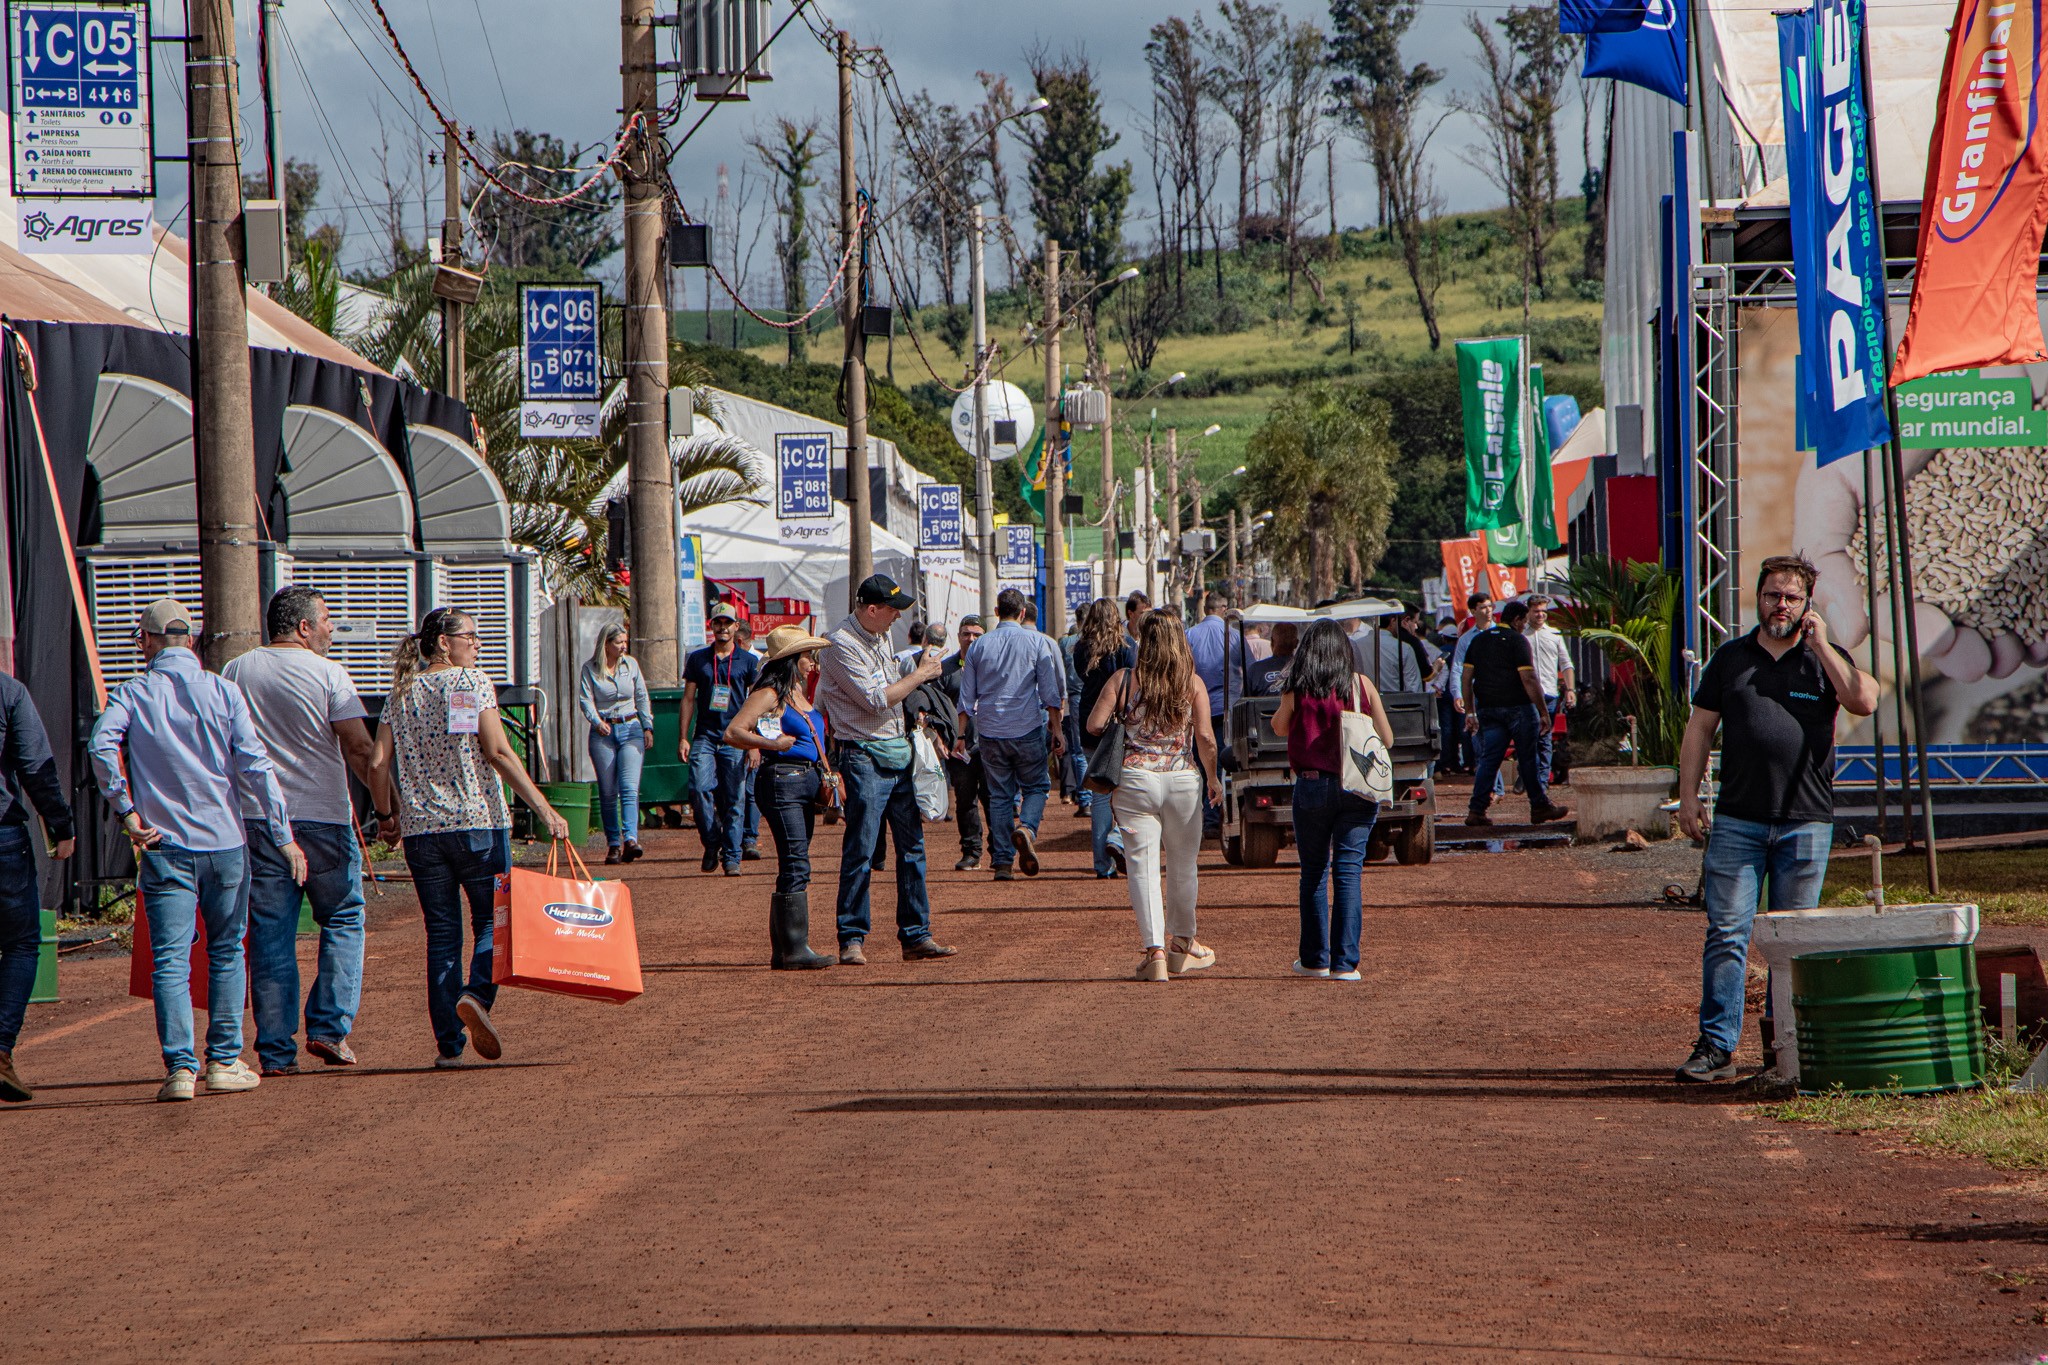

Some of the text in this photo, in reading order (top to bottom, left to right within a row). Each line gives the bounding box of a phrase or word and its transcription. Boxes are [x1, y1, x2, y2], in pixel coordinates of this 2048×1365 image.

[46, 20, 132, 66] C 05
[25, 87, 77, 101] D B
[88, 88, 131, 101] 4 6
[40, 109, 85, 118] SANITÁRIOS
[40, 129, 80, 137] IMPRENSA
[42, 148, 91, 158] SAÍDA NORTE
[42, 167, 65, 175] ARENA
[78, 168, 133, 176] CONHECIMENTO
[42, 177, 104, 186] Knowledge Arena
[1858, 190, 1871, 247] para
[53, 216, 143, 242] Agres
[541, 300, 593, 330] C 06
[563, 350, 583, 366] 07
[531, 363, 543, 380] D
[547, 358, 559, 375] B
[563, 371, 584, 387] 05
[1896, 390, 2015, 412] segurança
[541, 412, 596, 429] Agres
[1931, 416, 2031, 437] mundial.
[791, 445, 825, 467] C 07
[795, 487, 803, 499] B
[805, 480, 820, 492] 08
[784, 490, 792, 503] D
[806, 496, 820, 508] 06
[929, 491, 957, 510] C 08
[793, 526, 830, 539] Agres
[941, 532, 953, 543] 07
[1008, 528, 1030, 543] C 09
[932, 556, 961, 565] Agres
[1069, 572, 1090, 585] C 10
[1460, 555, 1475, 606] ACTO
[549, 906, 606, 921] Hidroazul
[548, 966, 571, 976] Mergulhe
[584, 970, 611, 981] confiança
